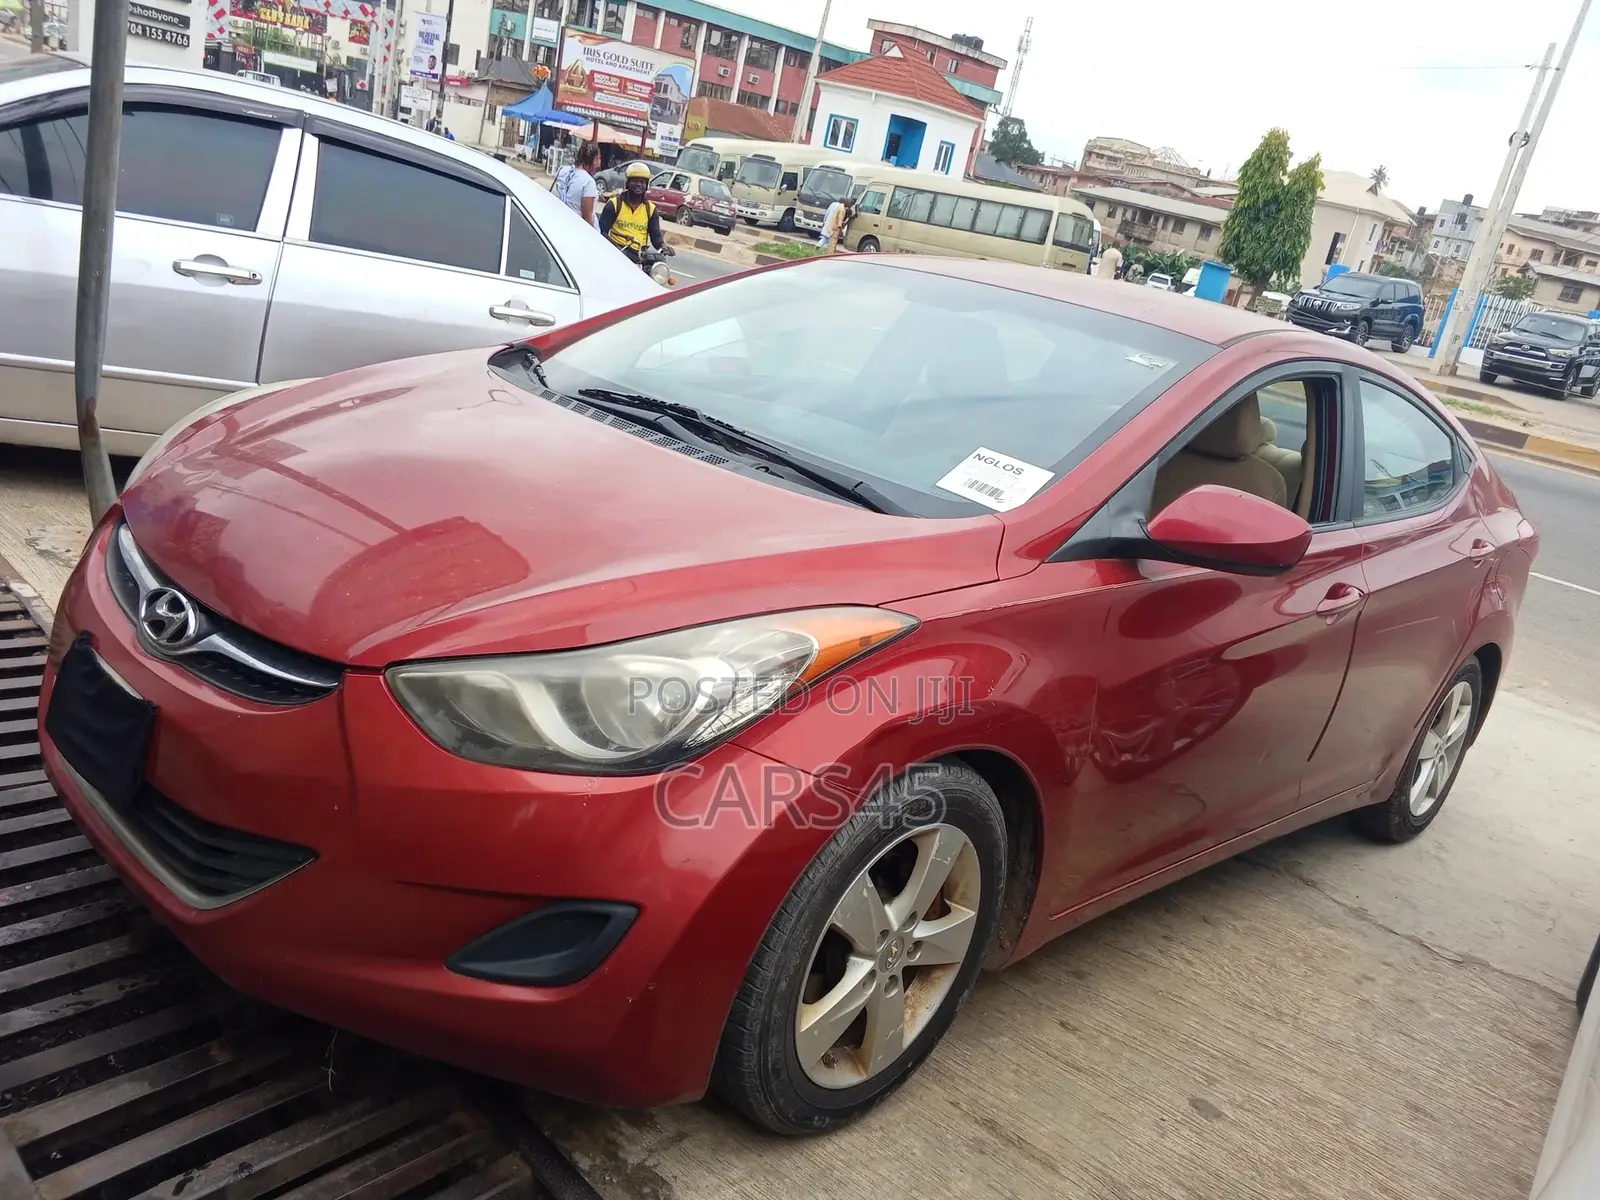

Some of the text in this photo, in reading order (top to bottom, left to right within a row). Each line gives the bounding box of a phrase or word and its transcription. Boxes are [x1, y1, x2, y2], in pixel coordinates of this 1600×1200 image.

[146, 26, 163, 40] 155
[165, 31, 189, 46] 4766
[583, 46, 656, 72] IRIS GOLD SUITE
[585, 56, 604, 65] HOTEL
[617, 64, 651, 76] APARTMENT
[972, 453, 1025, 476] NGLOS
